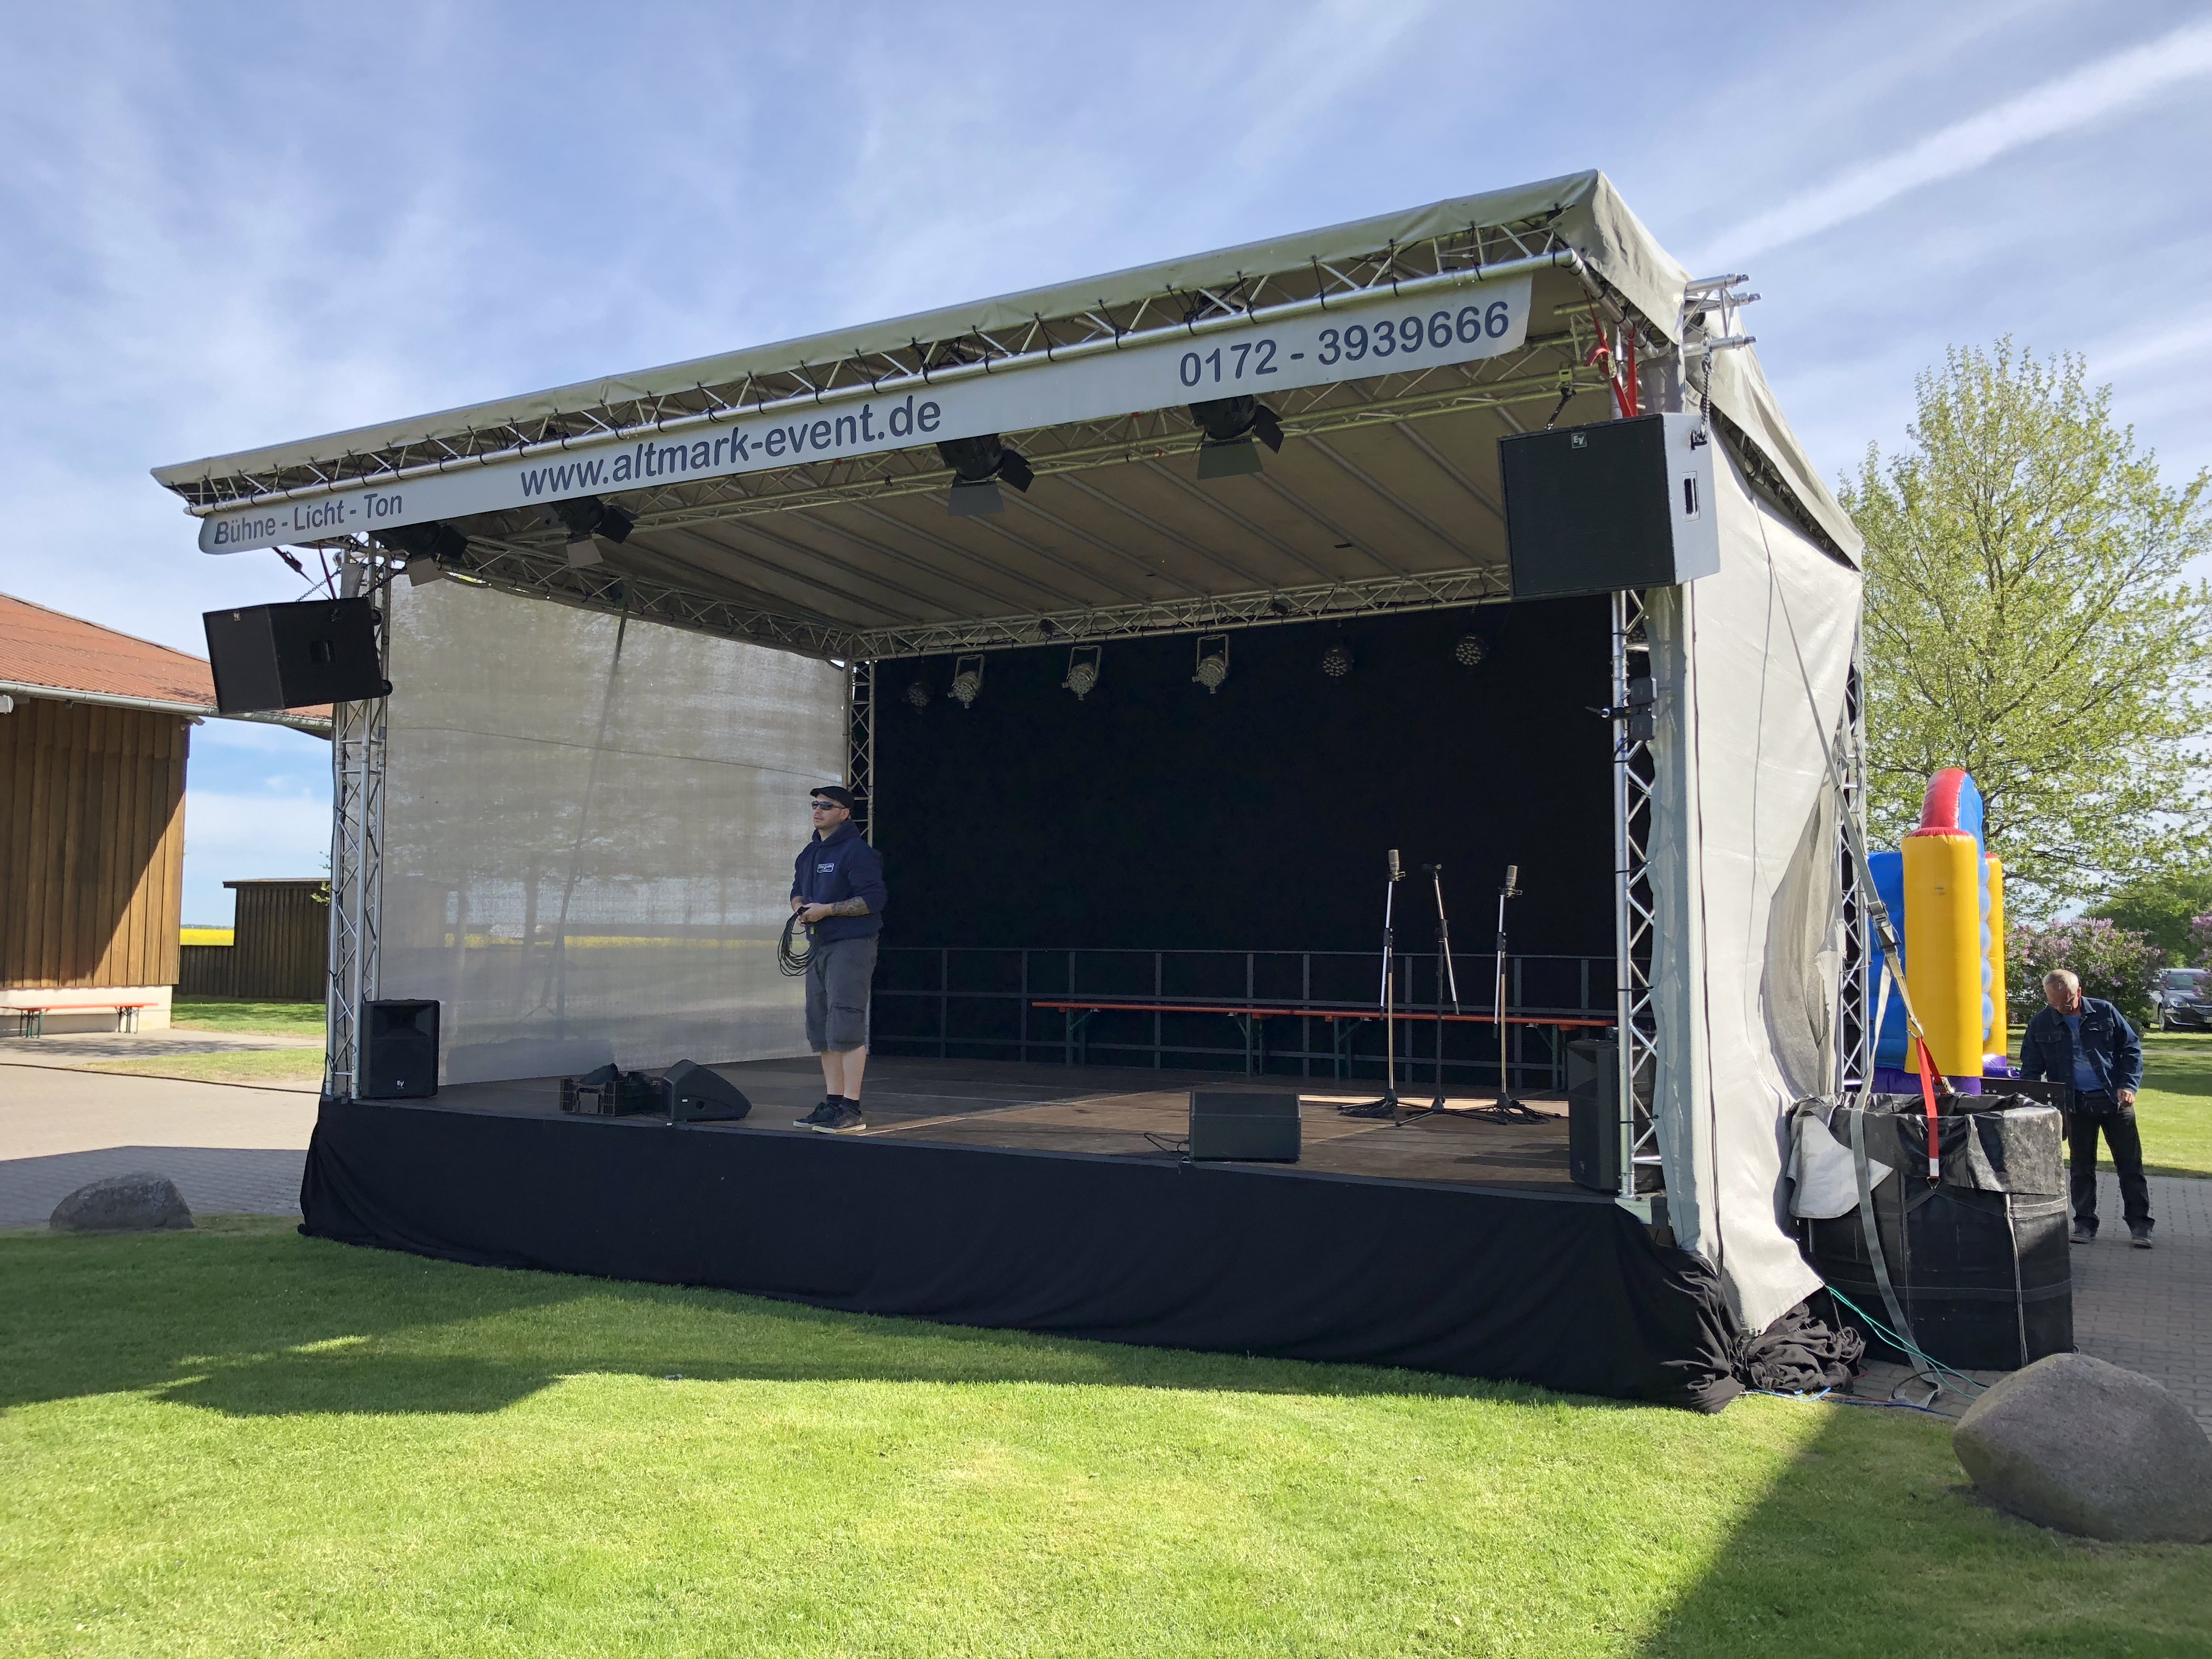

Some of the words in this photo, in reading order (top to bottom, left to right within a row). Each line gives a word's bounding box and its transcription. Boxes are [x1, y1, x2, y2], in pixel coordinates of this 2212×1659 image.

[1180, 339, 1278, 387] 0172
[1318, 301, 1509, 365] 3939666
[520, 395, 941, 497] www.altmark-event.de
[1573, 435, 1584, 445] EV
[214, 517, 276, 545] Bühne
[294, 500, 345, 532] Licht
[364, 494, 403, 519] Ton
